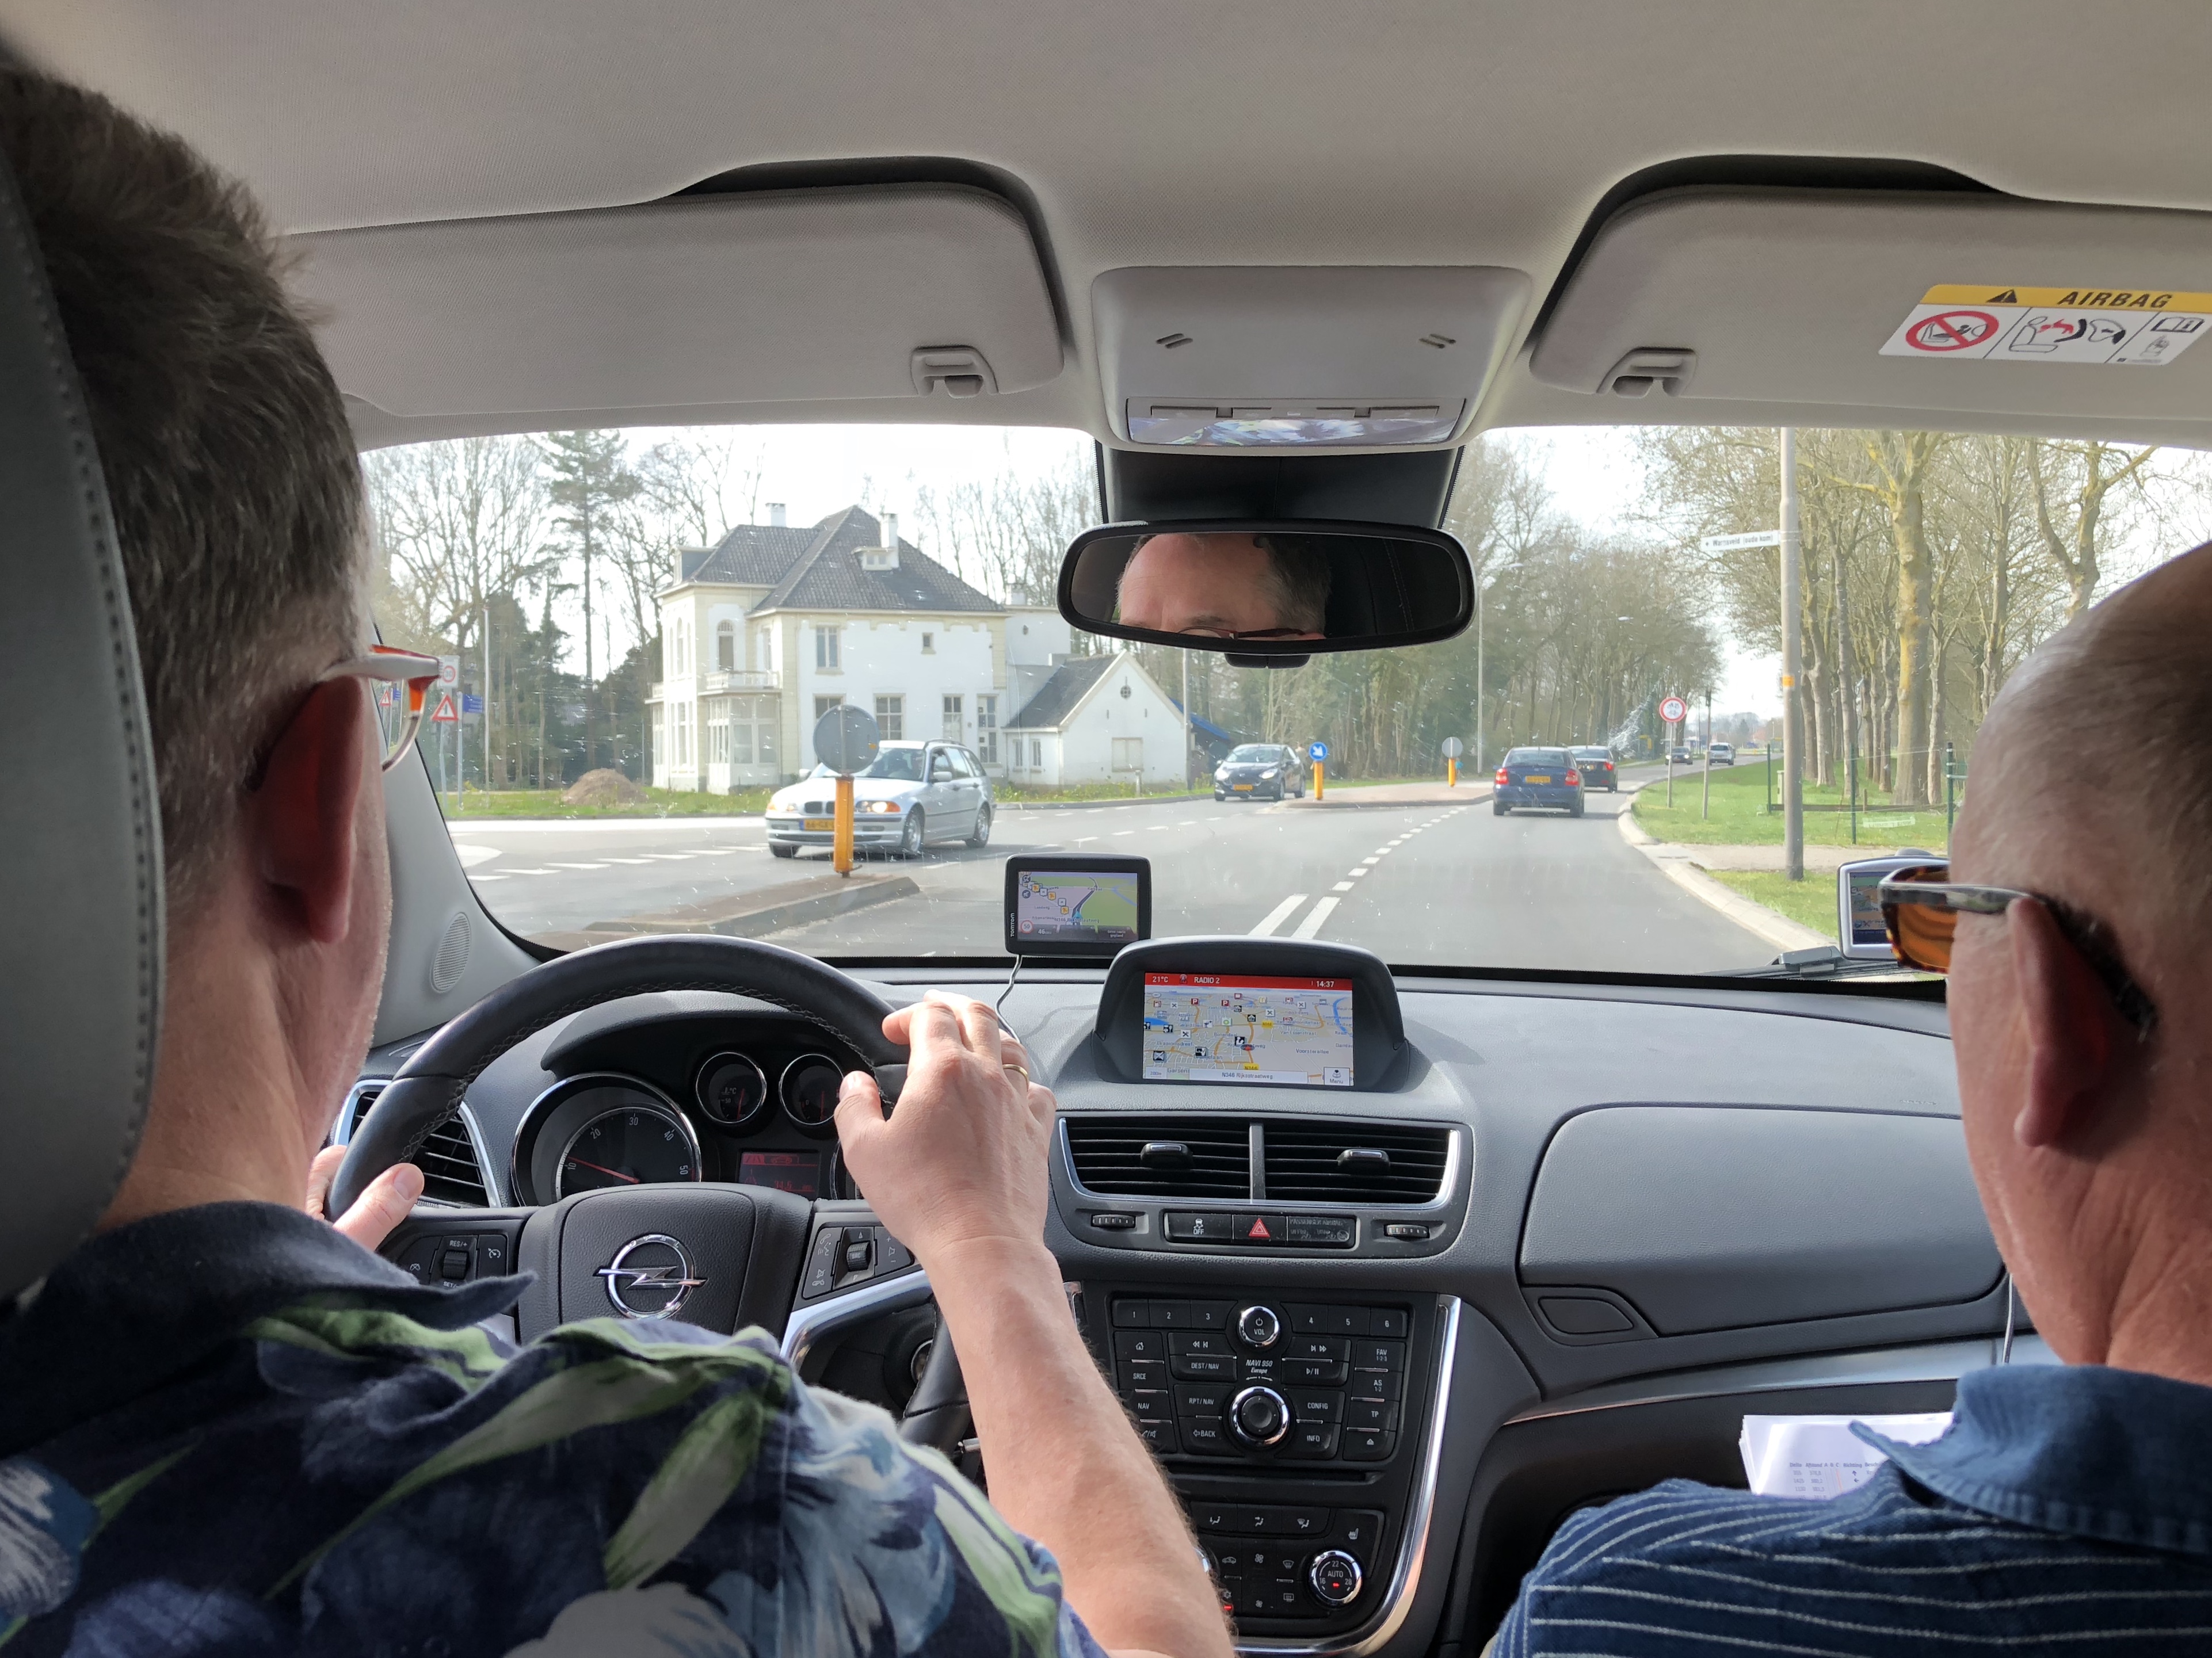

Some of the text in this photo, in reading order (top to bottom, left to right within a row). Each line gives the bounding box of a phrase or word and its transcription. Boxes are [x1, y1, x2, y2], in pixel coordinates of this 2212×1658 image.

[2057, 291, 2173, 308] AIRBAG
[629, 1117, 639, 1126] 30
[590, 1128, 601, 1140] 20
[663, 1130, 674, 1141] 40
[567, 1162, 577, 1170] 10
[679, 1164, 688, 1175] 50
